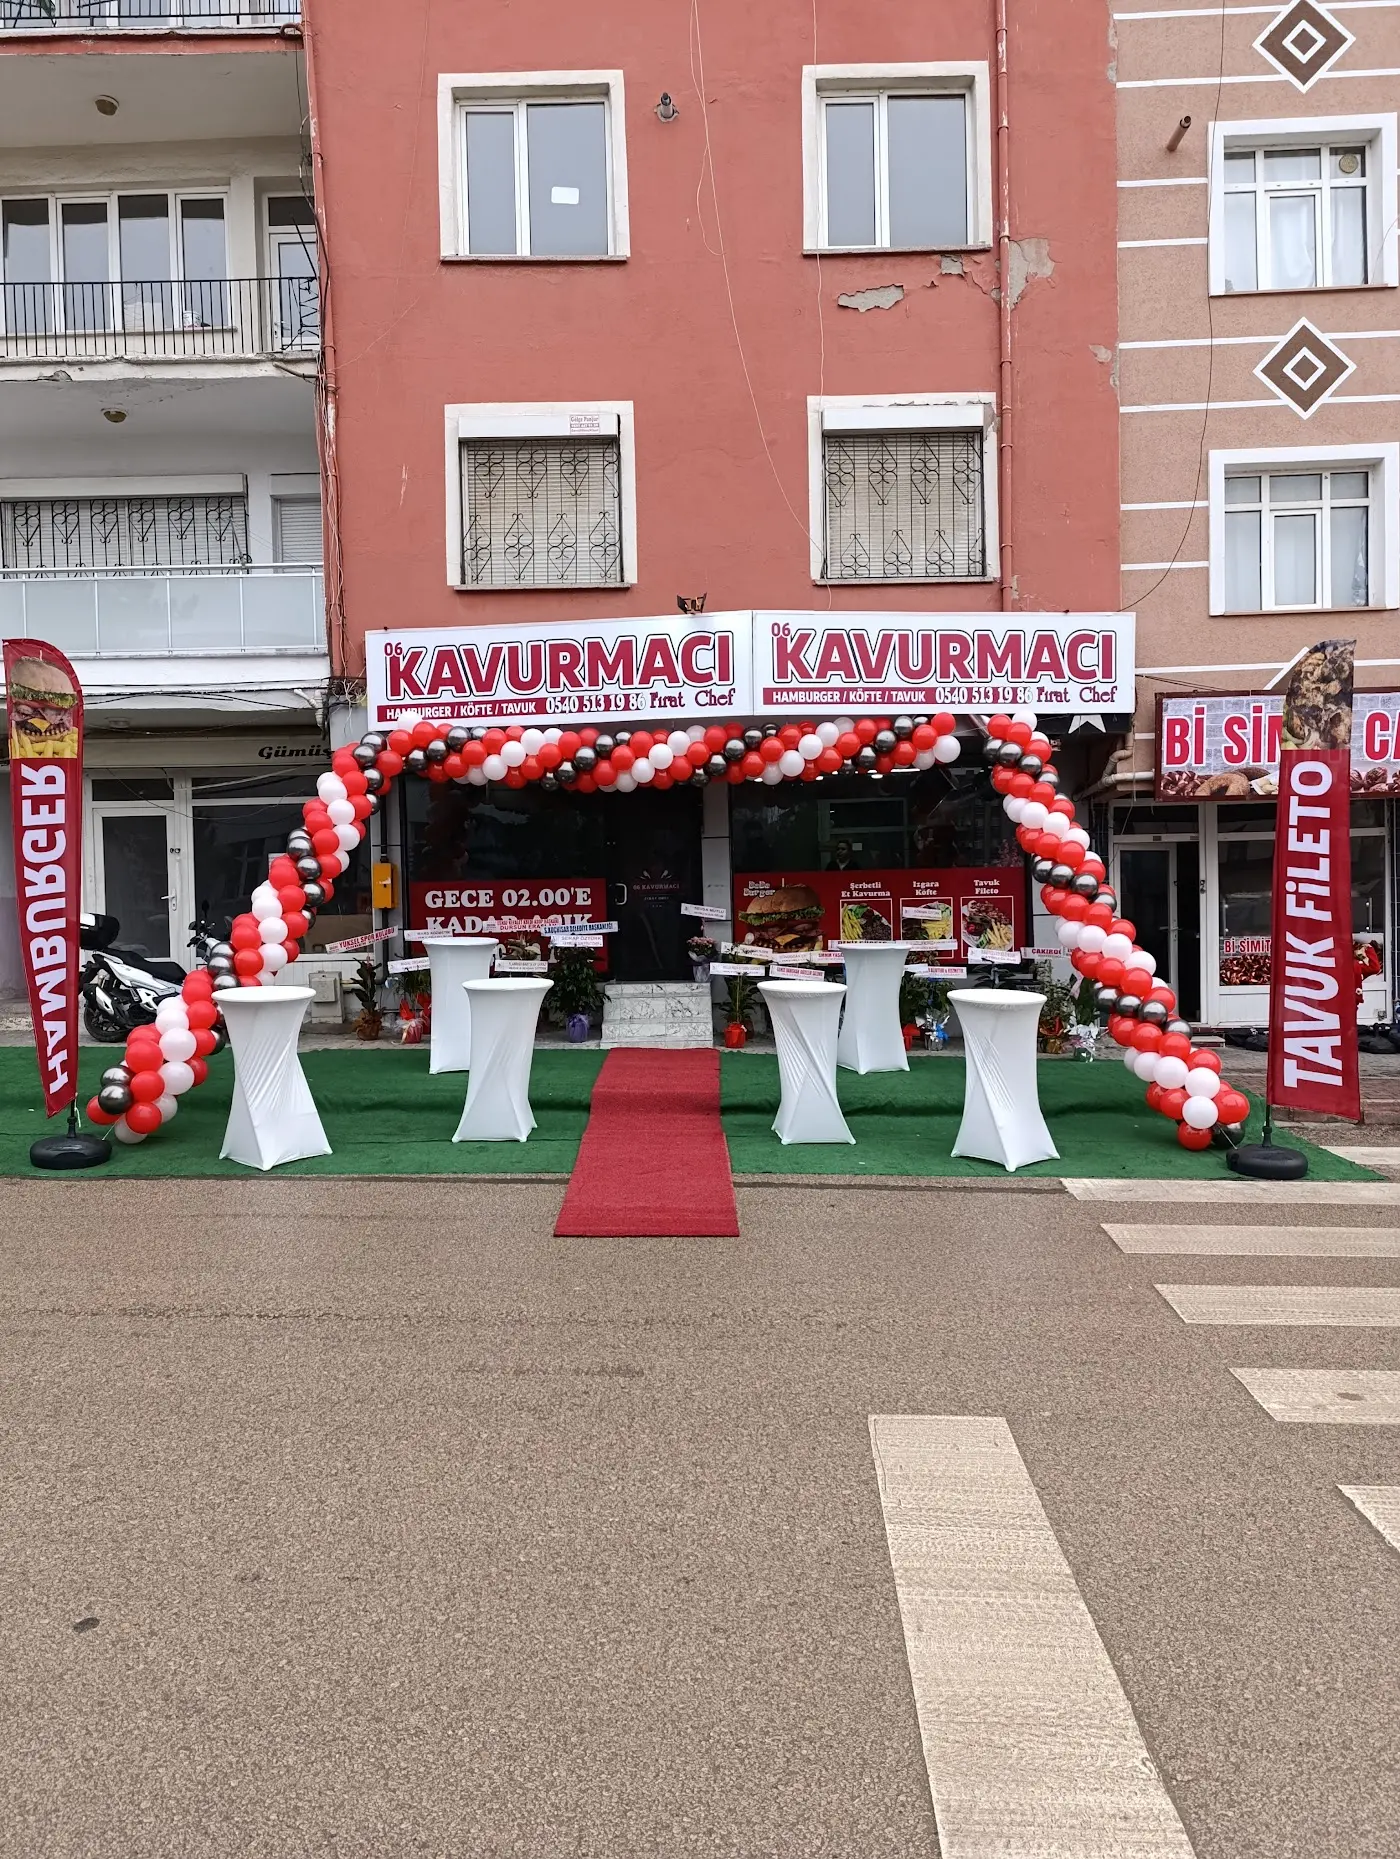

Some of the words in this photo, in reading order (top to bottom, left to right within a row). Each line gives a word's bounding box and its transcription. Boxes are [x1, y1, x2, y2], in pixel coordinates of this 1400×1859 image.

[771, 622, 791, 637] 06
[384, 642, 403, 656] 06
[774, 629, 1116, 683] KAVURMACI
[387, 632, 734, 700] KAVURMACI
[694, 688, 736, 707] Chef
[773, 690, 841, 703] HAMBURGER
[849, 688, 883, 703] KÖFTE
[891, 690, 926, 702] TAVUK
[935, 687, 968, 705] 0540
[972, 687, 993, 703] 513
[997, 686, 1013, 703] 19
[1016, 686, 1033, 703] 86
[1079, 686, 1118, 703] Chef
[460, 702, 493, 717] KÖFTE
[501, 701, 536, 714] TAVUK
[545, 695, 578, 714] 0540
[583, 694, 605, 712] 513
[609, 693, 625, 711] 19
[629, 692, 646, 711] 86
[1165, 704, 1206, 766] Bİ
[849, 881, 882, 890] Şerbetli
[973, 879, 1001, 887] Tavuk
[975, 887, 999, 895] Fileto
[424, 889, 494, 908] GECE
[502, 887, 592, 907] 02.00'E
[841, 890, 851, 898] Et
[852, 889, 891, 898] Kavurma
[915, 888, 938, 896] Köfte
[1283, 930, 1344, 1089] TAVUK
